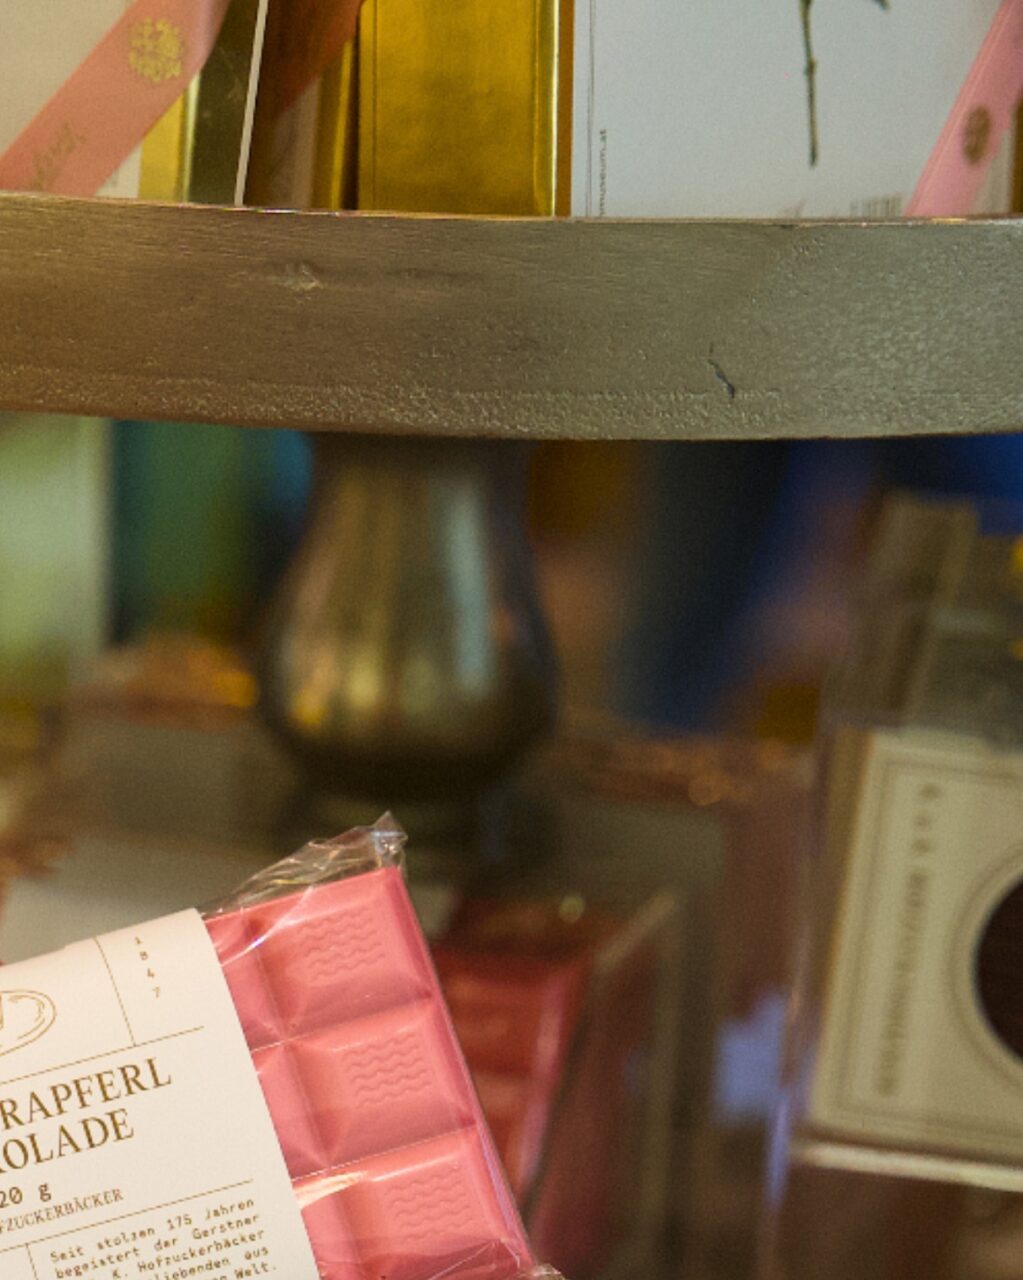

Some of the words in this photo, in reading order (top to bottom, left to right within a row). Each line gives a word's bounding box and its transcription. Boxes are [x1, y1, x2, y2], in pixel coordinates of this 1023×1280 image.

[134, 936, 161, 999] 1847
[38, 1183, 52, 1202] g
[50, 1246, 84, 1263] Seit
[97, 1227, 155, 1250] stolzen
[166, 1214, 193, 1231] 175
[204, 1198, 254, 1220] Jahren
[54, 1248, 140, 1279] begeistert
[154, 1237, 178, 1251] der
[191, 1214, 260, 1240] Gerstner
[111, 1269, 129, 1280] K.
[137, 1229, 265, 1273] Hofzuckerbäcker
[244, 1247, 269, 1260] aus
[234, 1262, 278, 1280] Welt.
